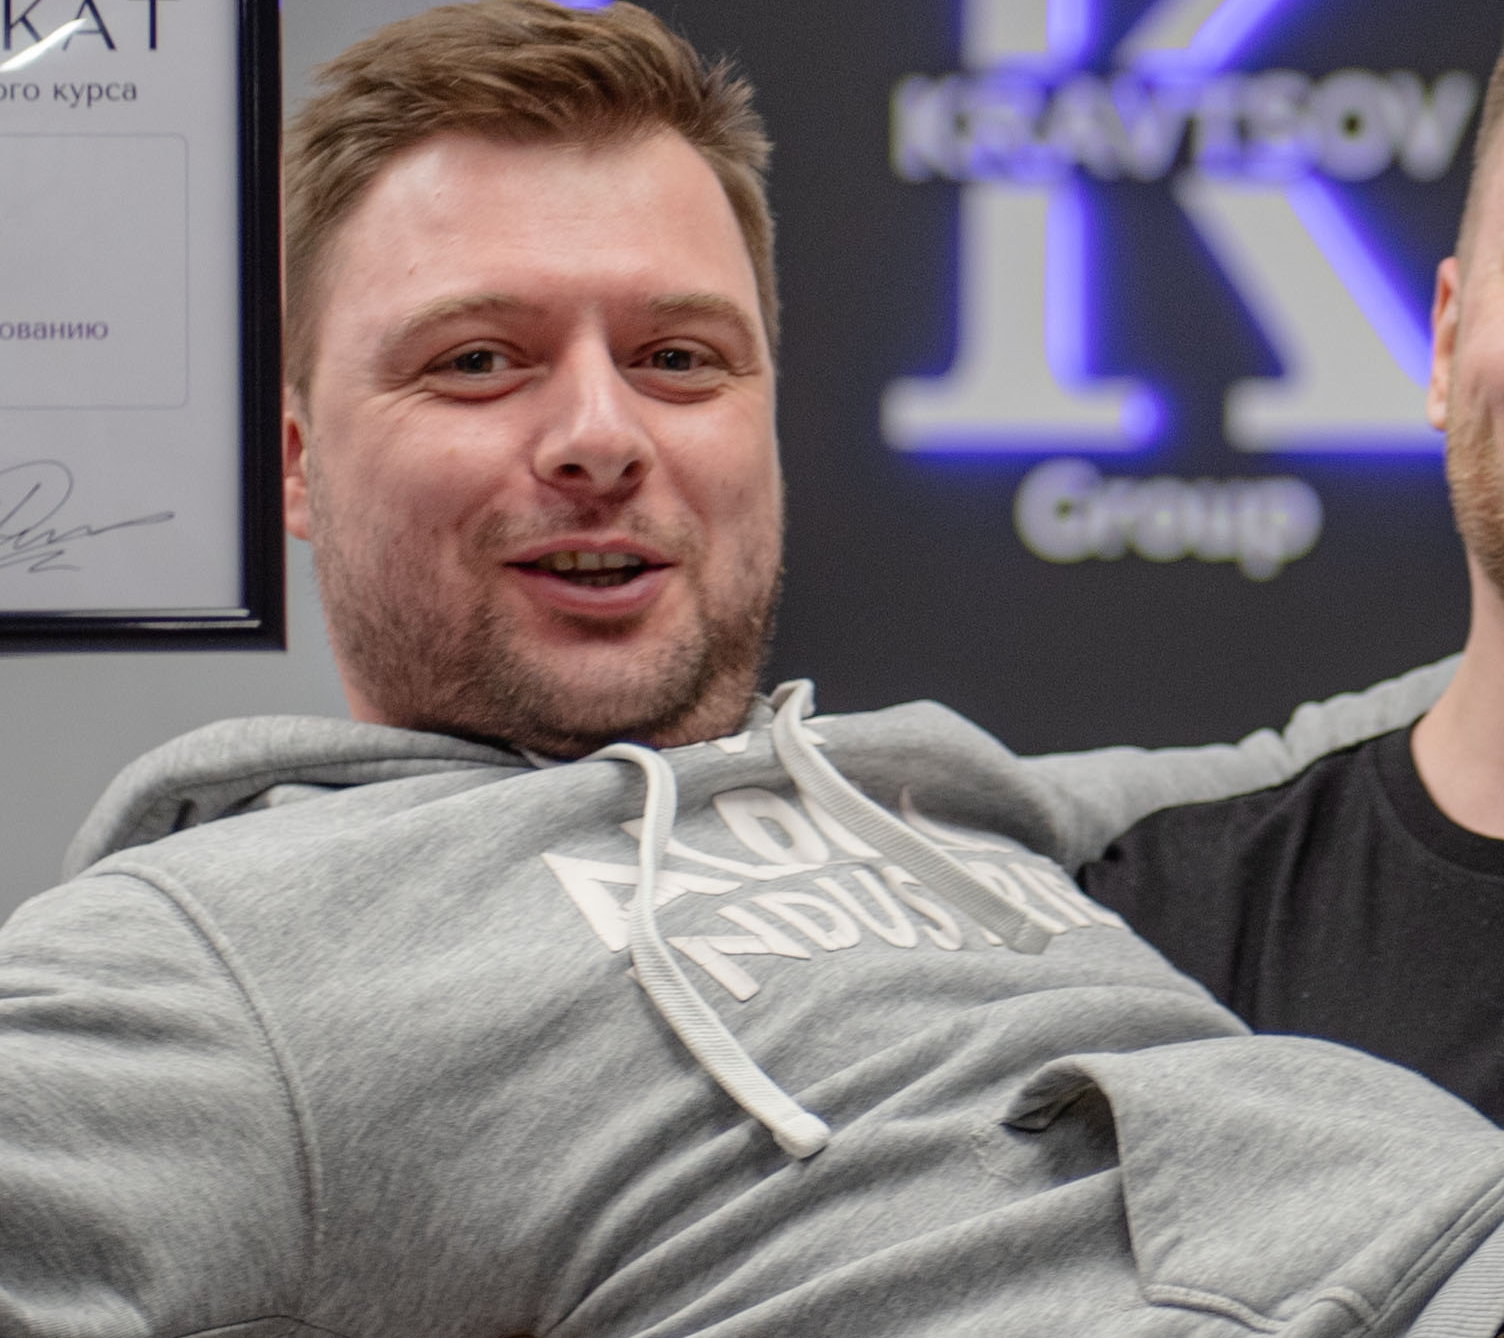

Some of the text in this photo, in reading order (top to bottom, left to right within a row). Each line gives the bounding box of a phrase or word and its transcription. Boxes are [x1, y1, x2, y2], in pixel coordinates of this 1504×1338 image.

[53, 82, 137, 108] курса
[891, 71, 1479, 183] KRAVTSOV
[1013, 458, 1324, 582] Group
